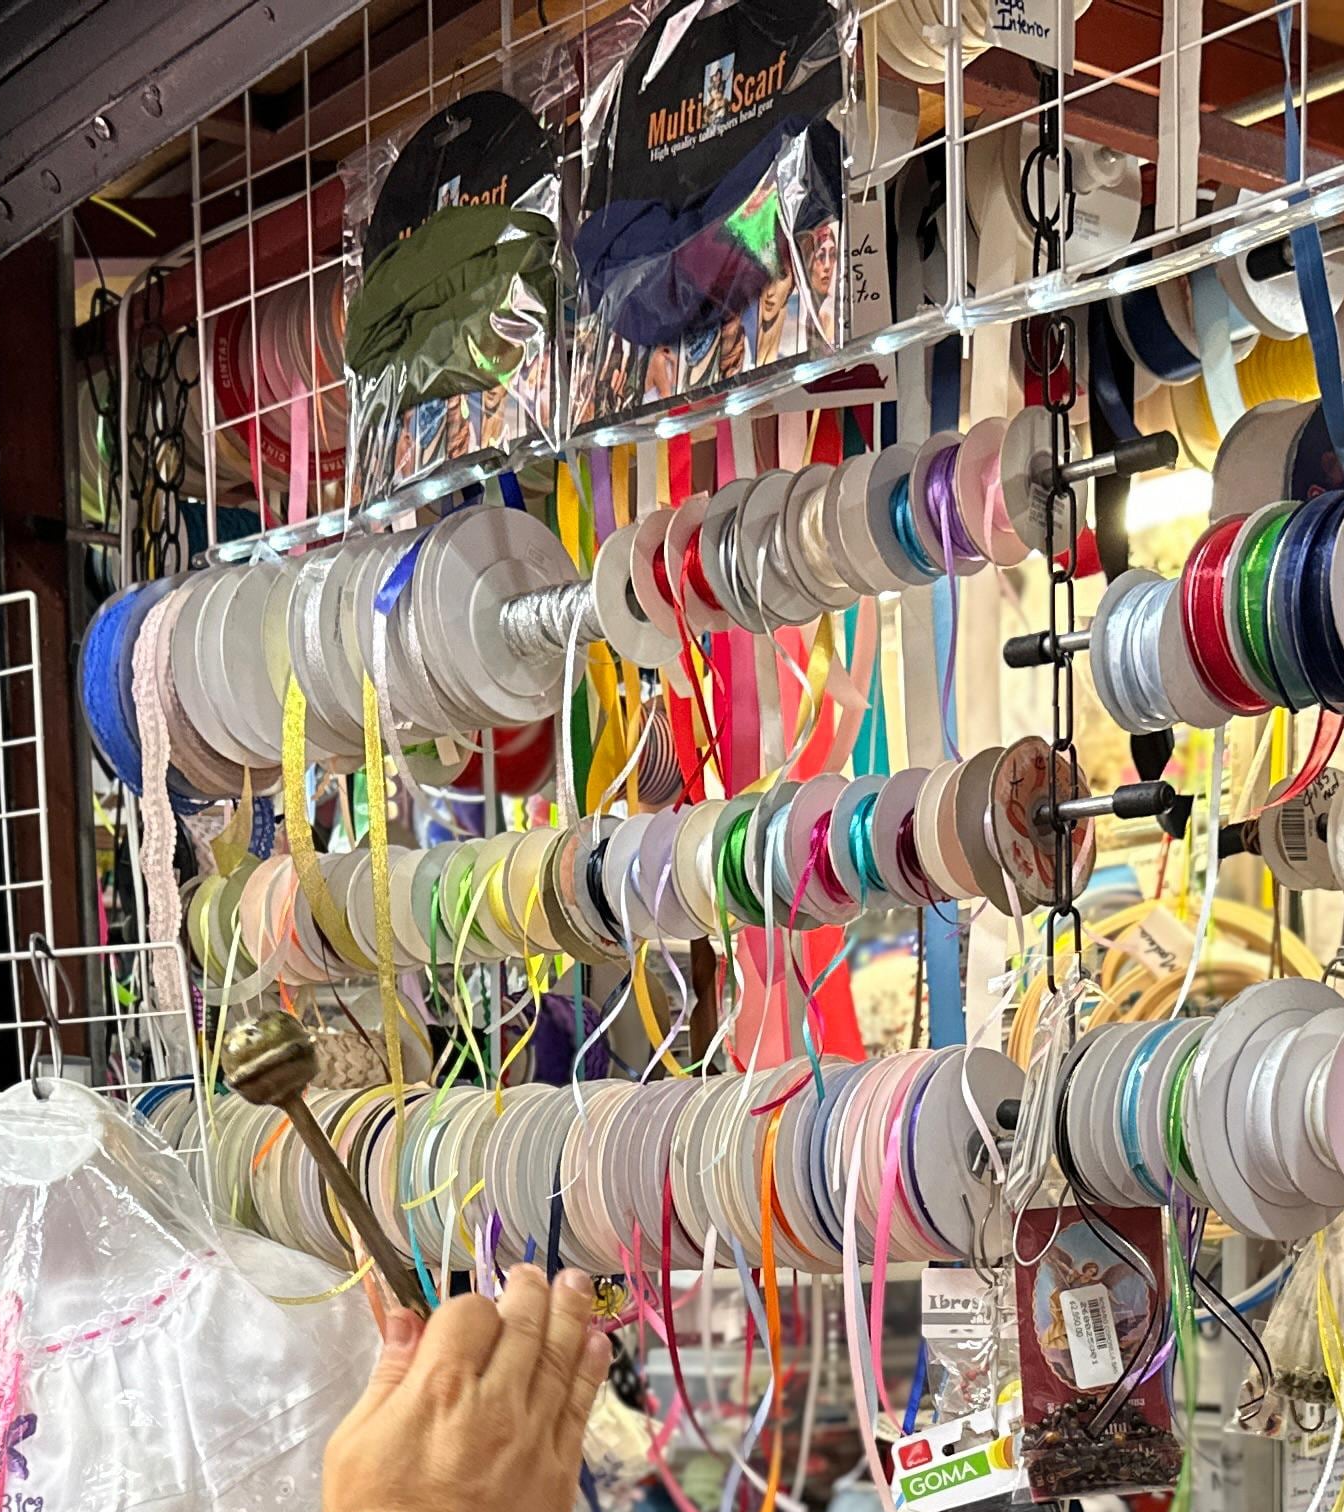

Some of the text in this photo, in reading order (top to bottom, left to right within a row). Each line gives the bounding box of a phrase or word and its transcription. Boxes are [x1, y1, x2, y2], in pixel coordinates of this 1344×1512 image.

[648, 50, 787, 149] Multi Scarf
[650, 145, 670, 162] High
[910, 1462, 977, 1496] GOMA
